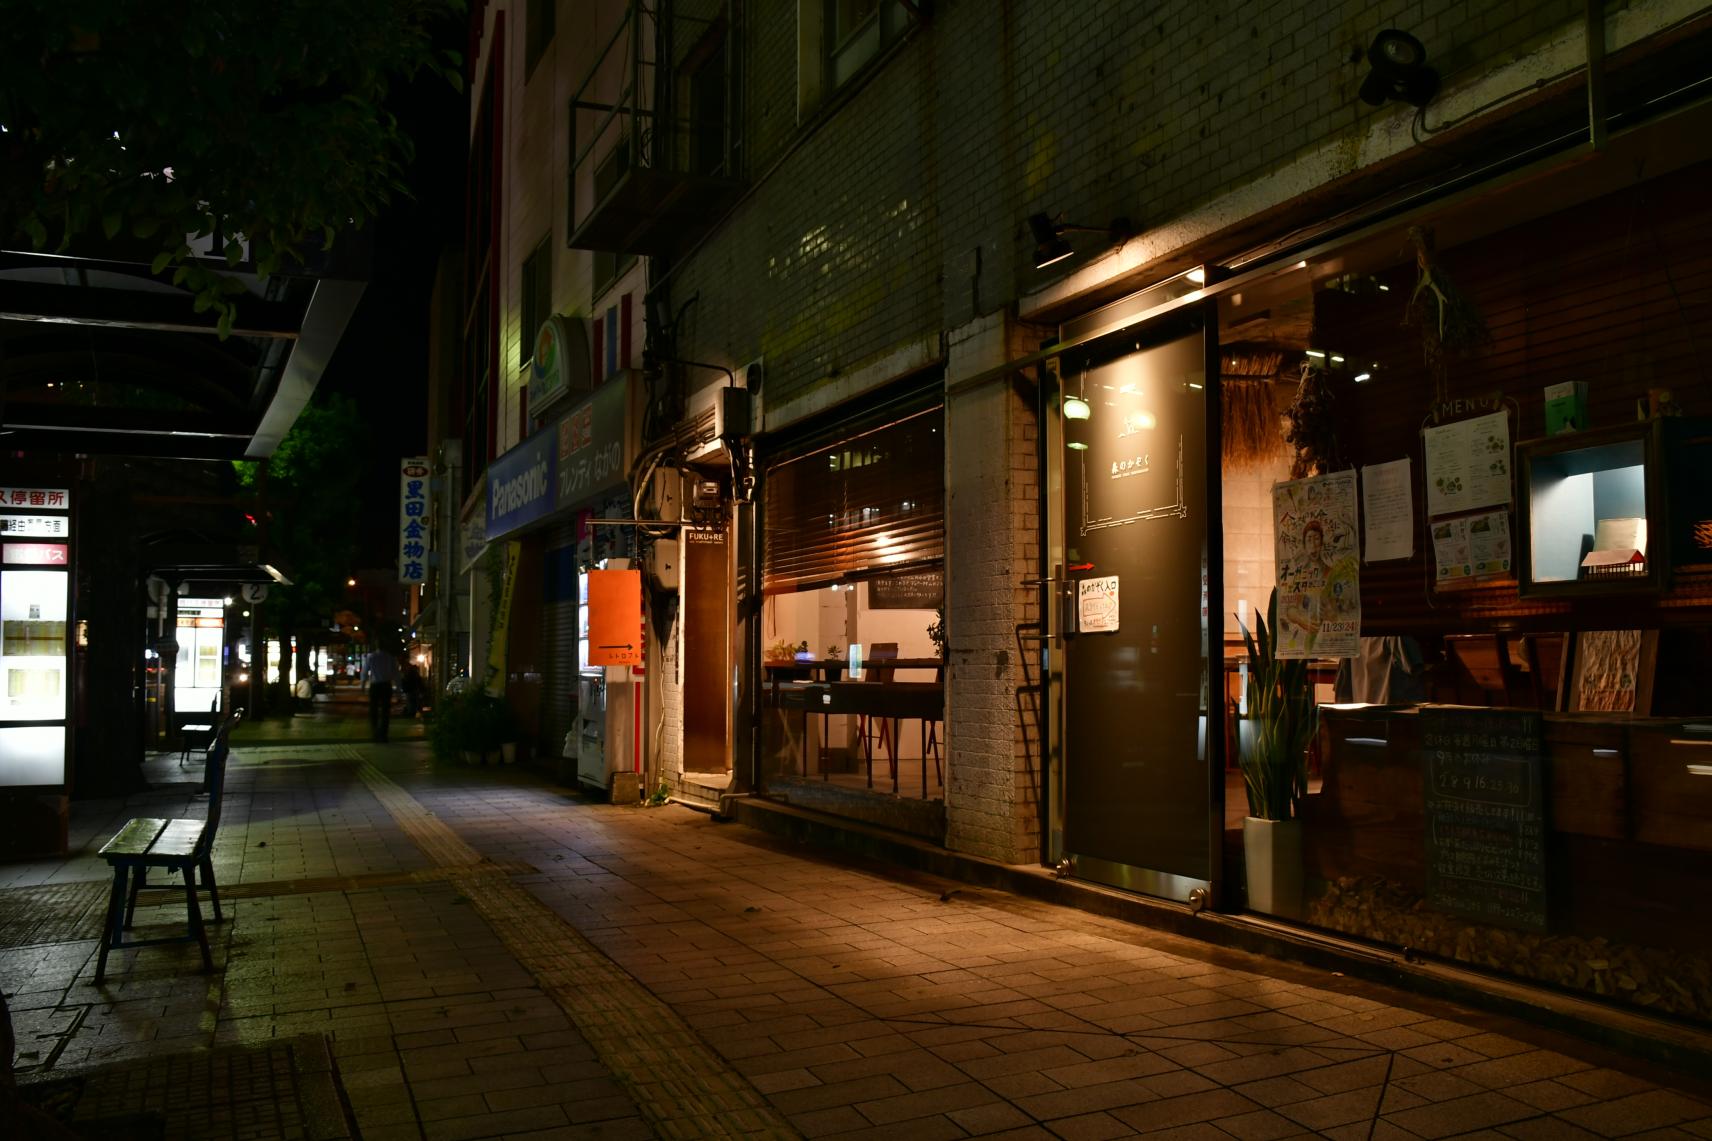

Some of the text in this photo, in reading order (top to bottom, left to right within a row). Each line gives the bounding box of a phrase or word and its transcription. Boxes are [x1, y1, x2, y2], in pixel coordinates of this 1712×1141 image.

[1442, 399, 1490, 417] MENU
[492, 451, 549, 521] Panasonic
[404, 480, 426, 580] 黒田金物店
[248, 585, 260, 602] 2
